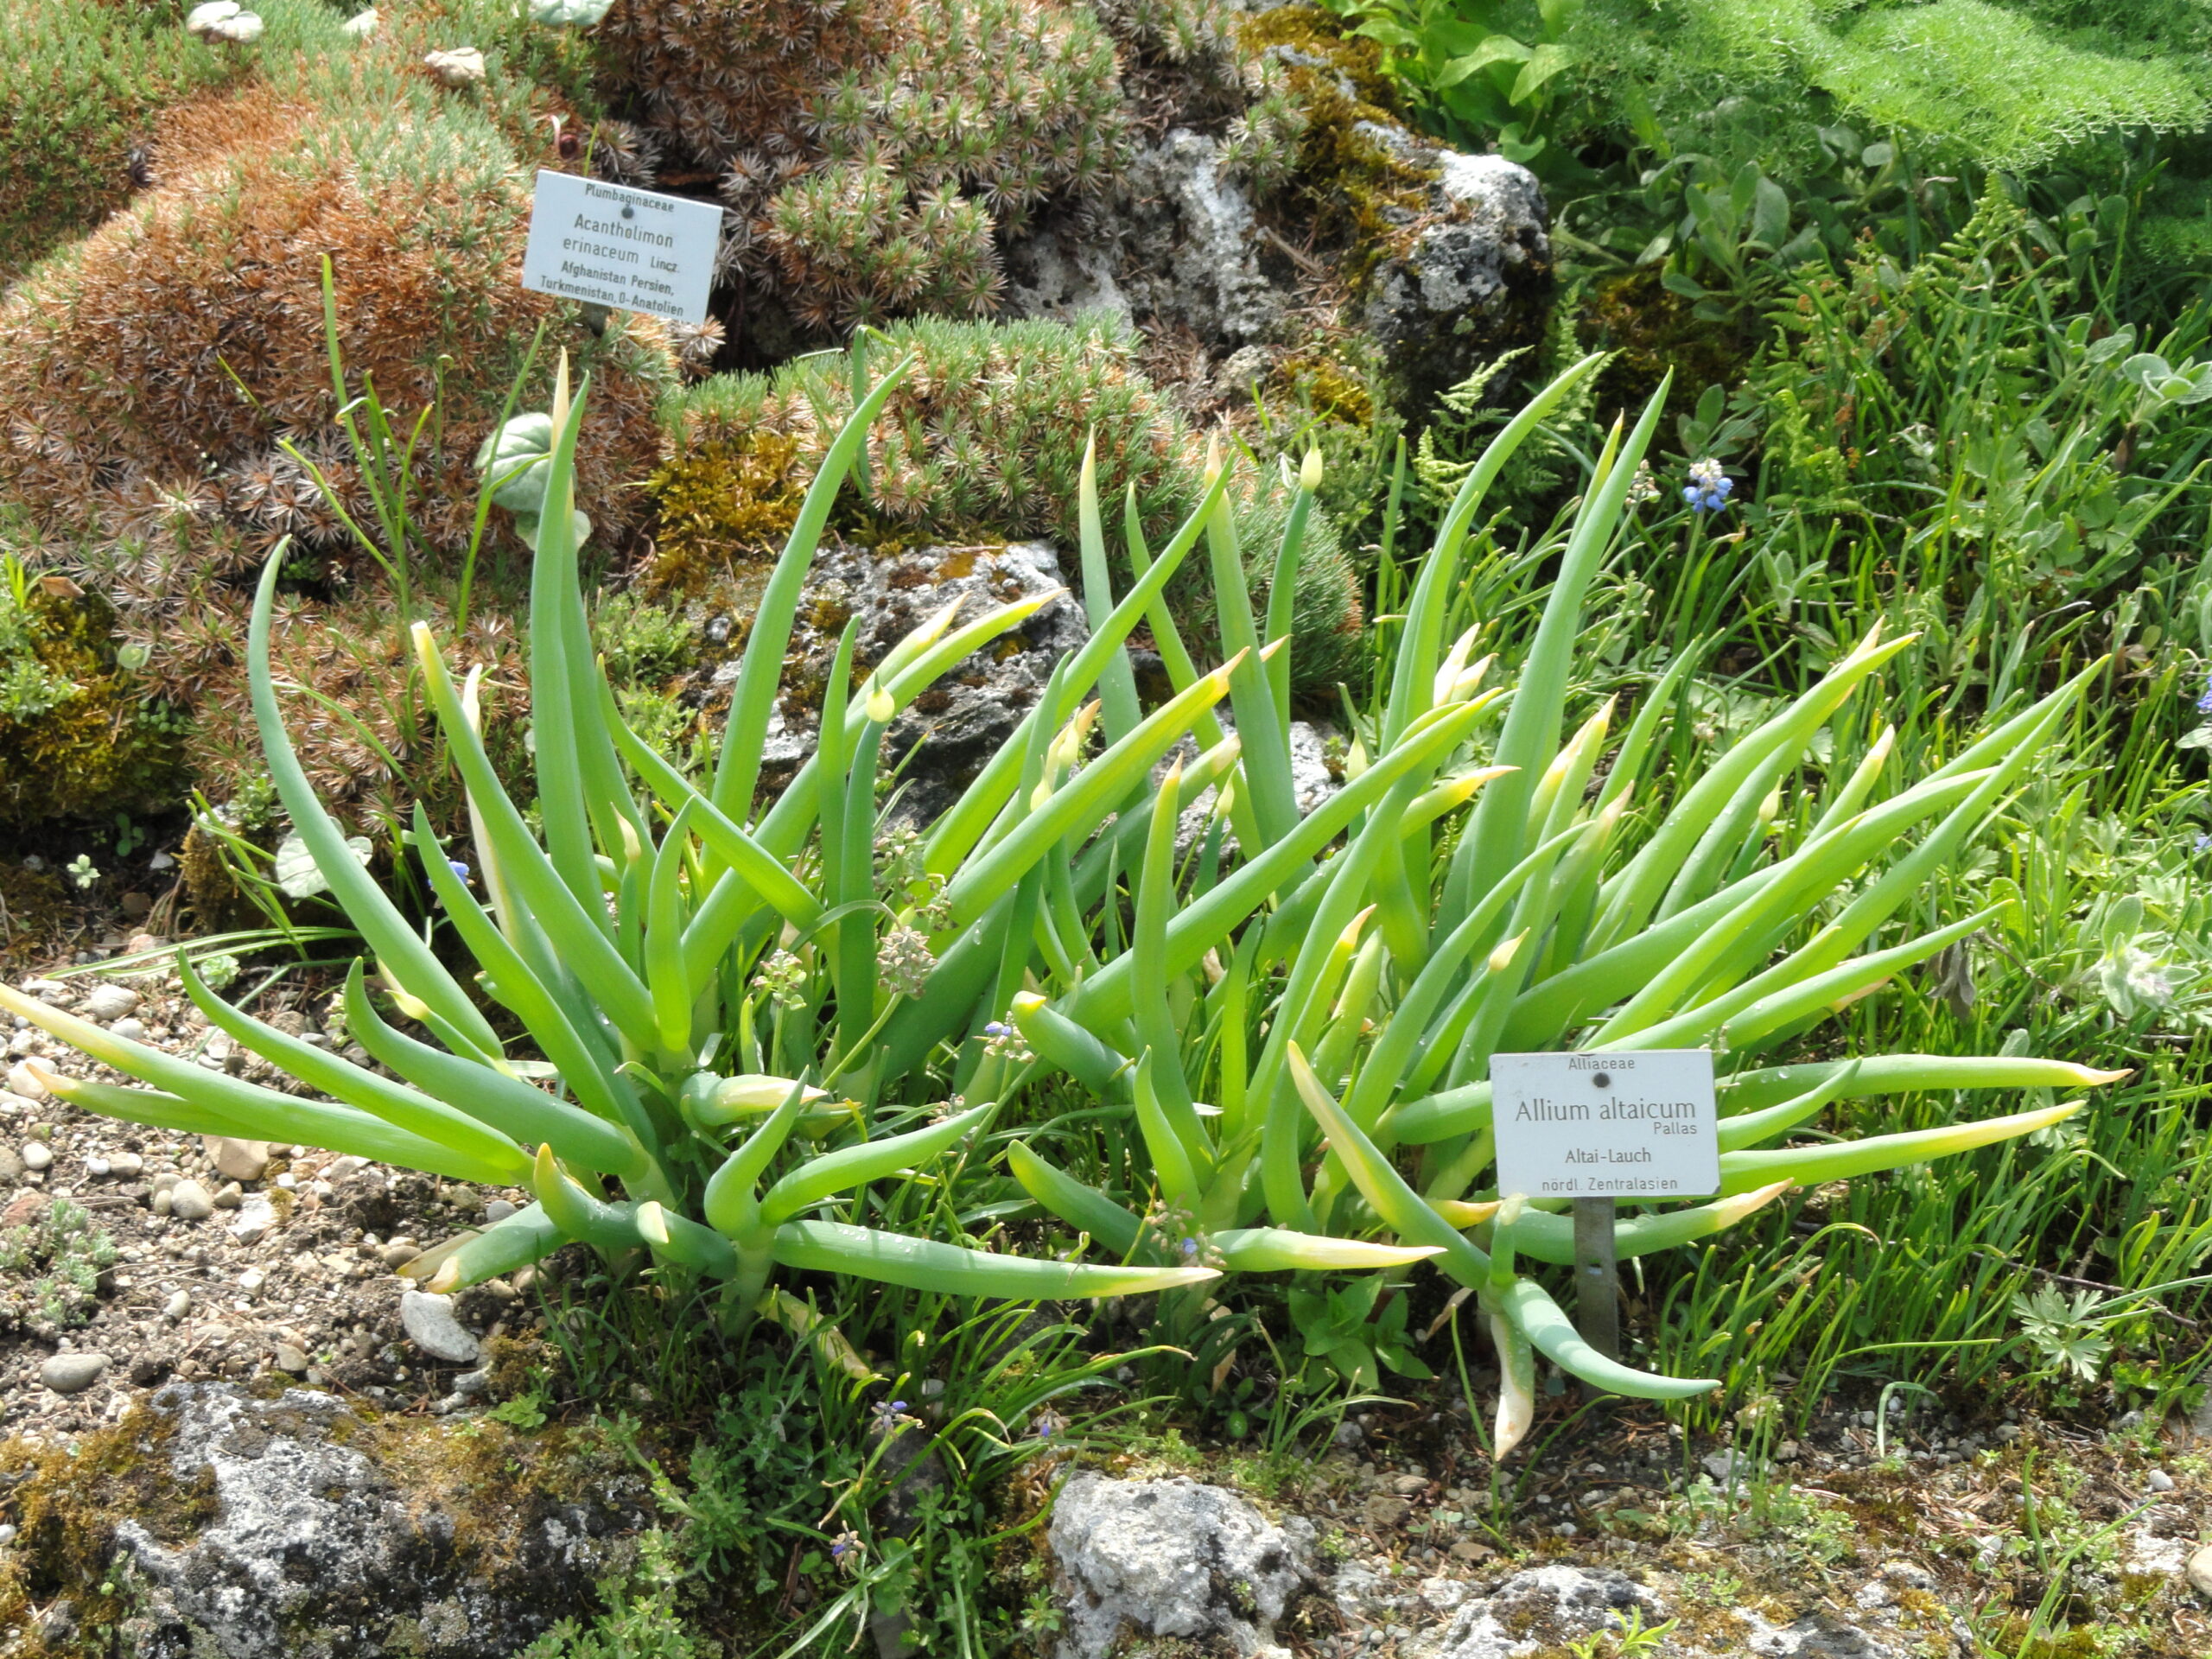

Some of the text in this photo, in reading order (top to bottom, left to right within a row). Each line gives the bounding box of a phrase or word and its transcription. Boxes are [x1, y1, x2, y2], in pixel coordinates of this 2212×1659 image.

[585, 183, 675, 213] Plumbaginaceae
[574, 213, 674, 248] Acantholimon
[563, 237, 680, 273] erinaceum Lincz.
[561, 261, 675, 296] Afghanistan Persien,
[1568, 1057, 1636, 1071] Alliaceae
[1516, 1096, 1696, 1122] Allium altaicum
[1654, 1122, 1697, 1135] Pallas
[1565, 1147, 1652, 1164] Altai-Lauch
[1542, 1177, 1678, 1191] nördl. Zentralasien
